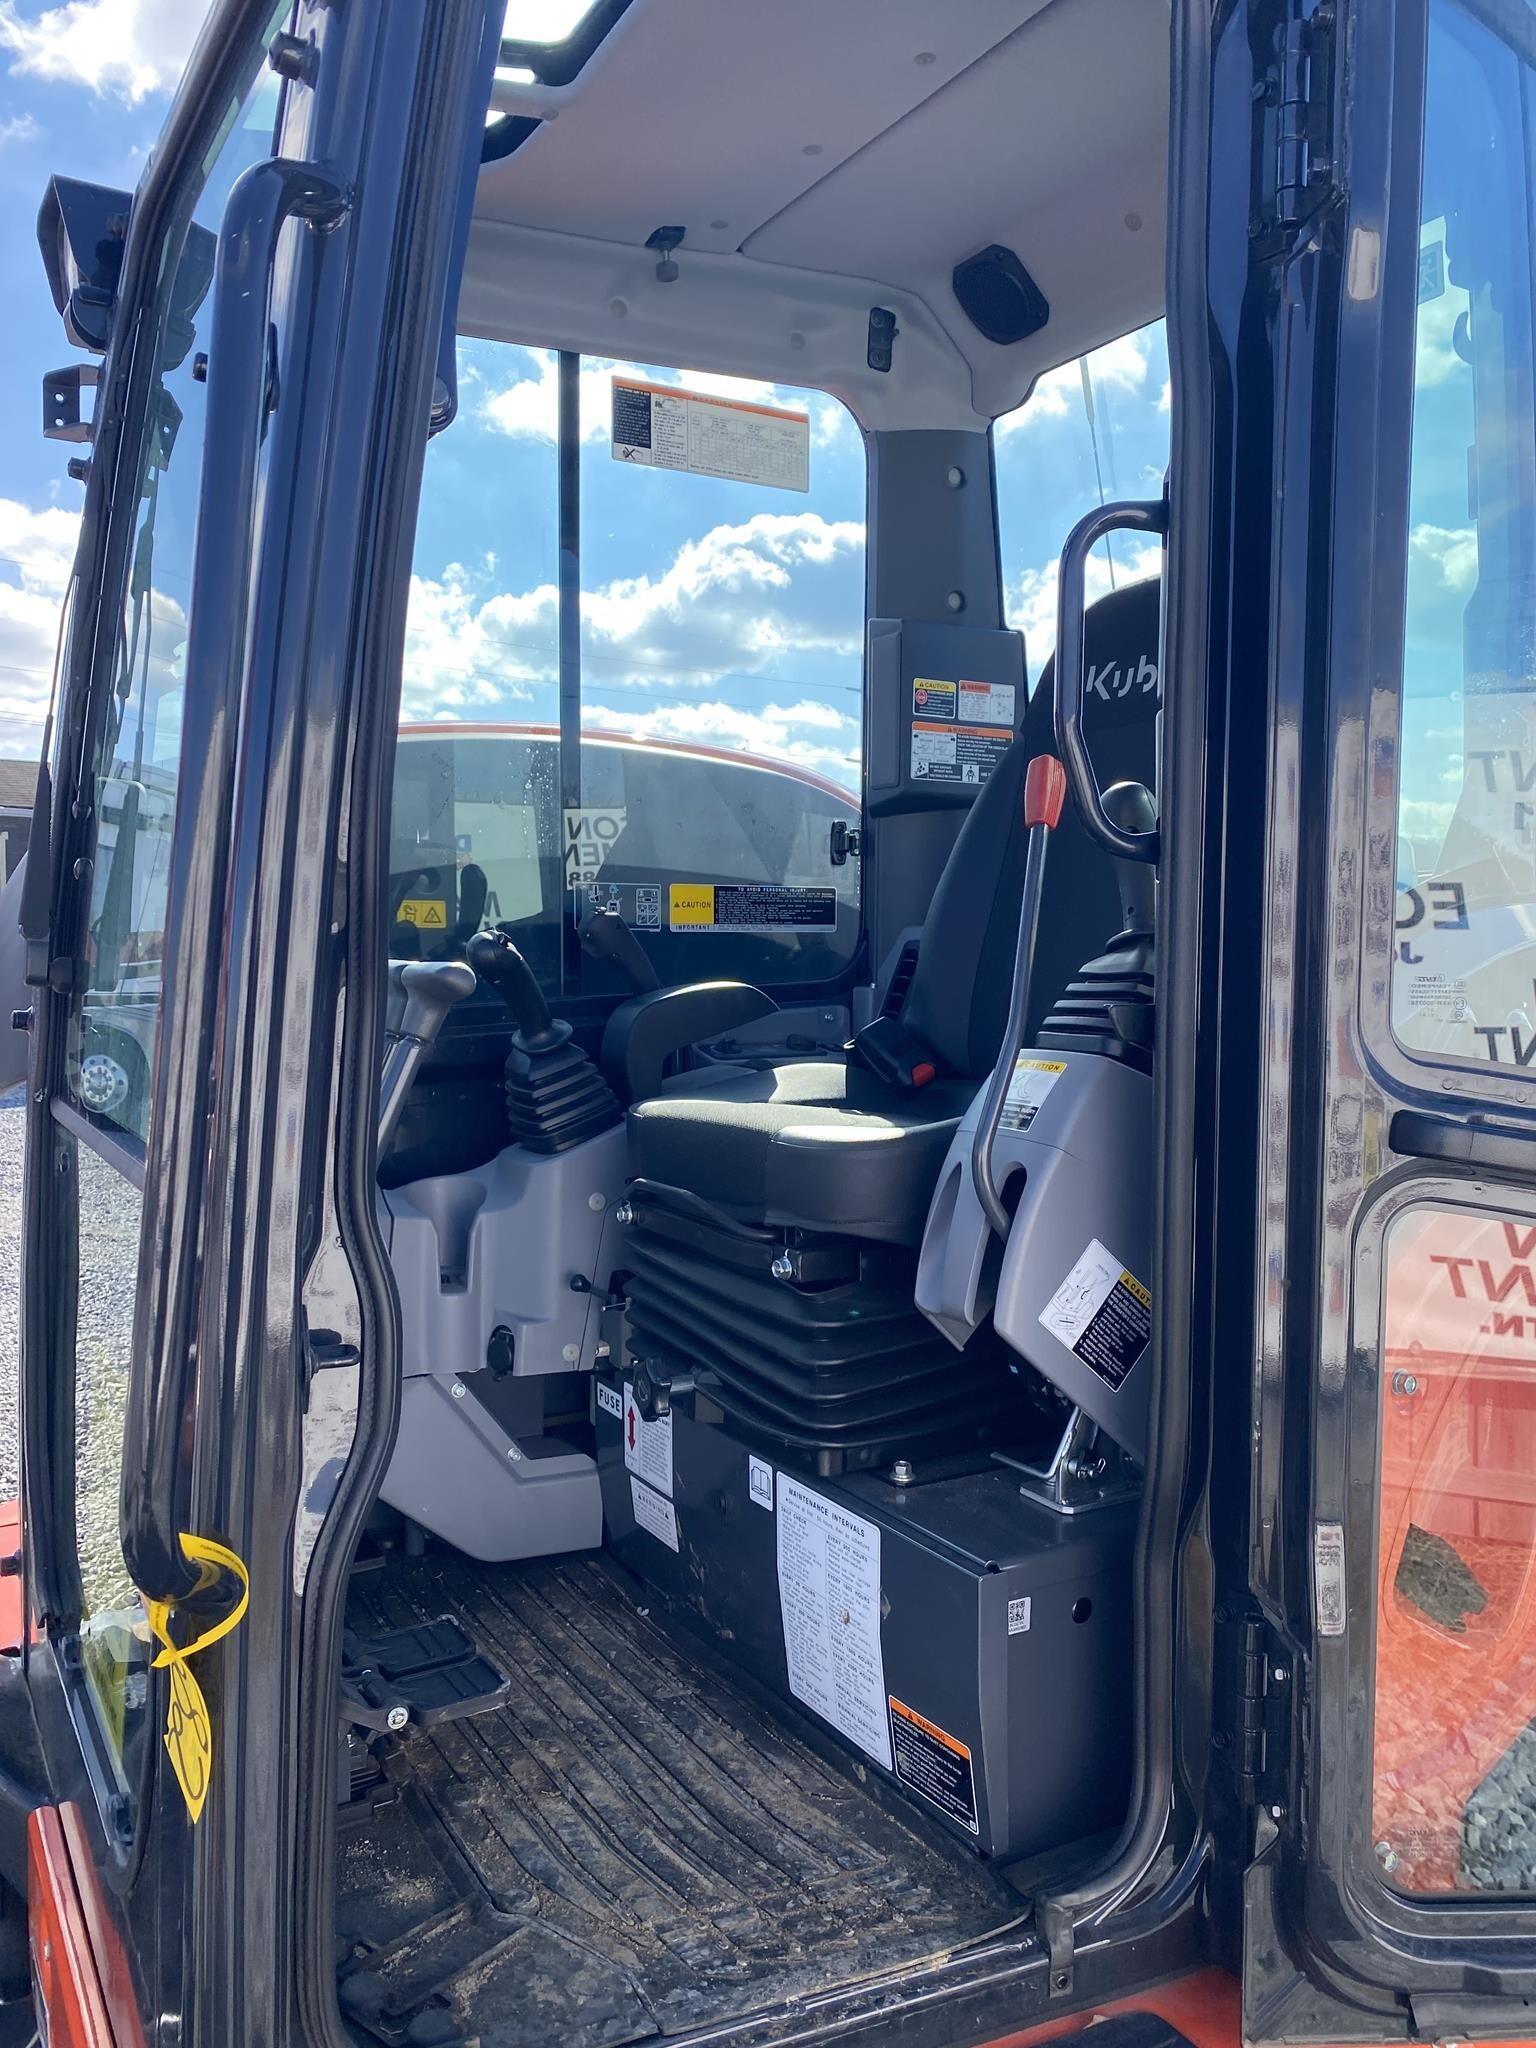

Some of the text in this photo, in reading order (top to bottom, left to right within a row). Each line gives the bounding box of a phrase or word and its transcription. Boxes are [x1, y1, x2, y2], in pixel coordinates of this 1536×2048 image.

[925, 682, 949, 690] CAUTION
[681, 901, 711, 909] CAUTION
[1131, 1283, 1151, 1306] CAUT
[599, 1389, 621, 1413] FUSE
[788, 1487, 865, 1537] MAINTENANCE INTERVALS
[917, 1716, 946, 1742] WARNING
